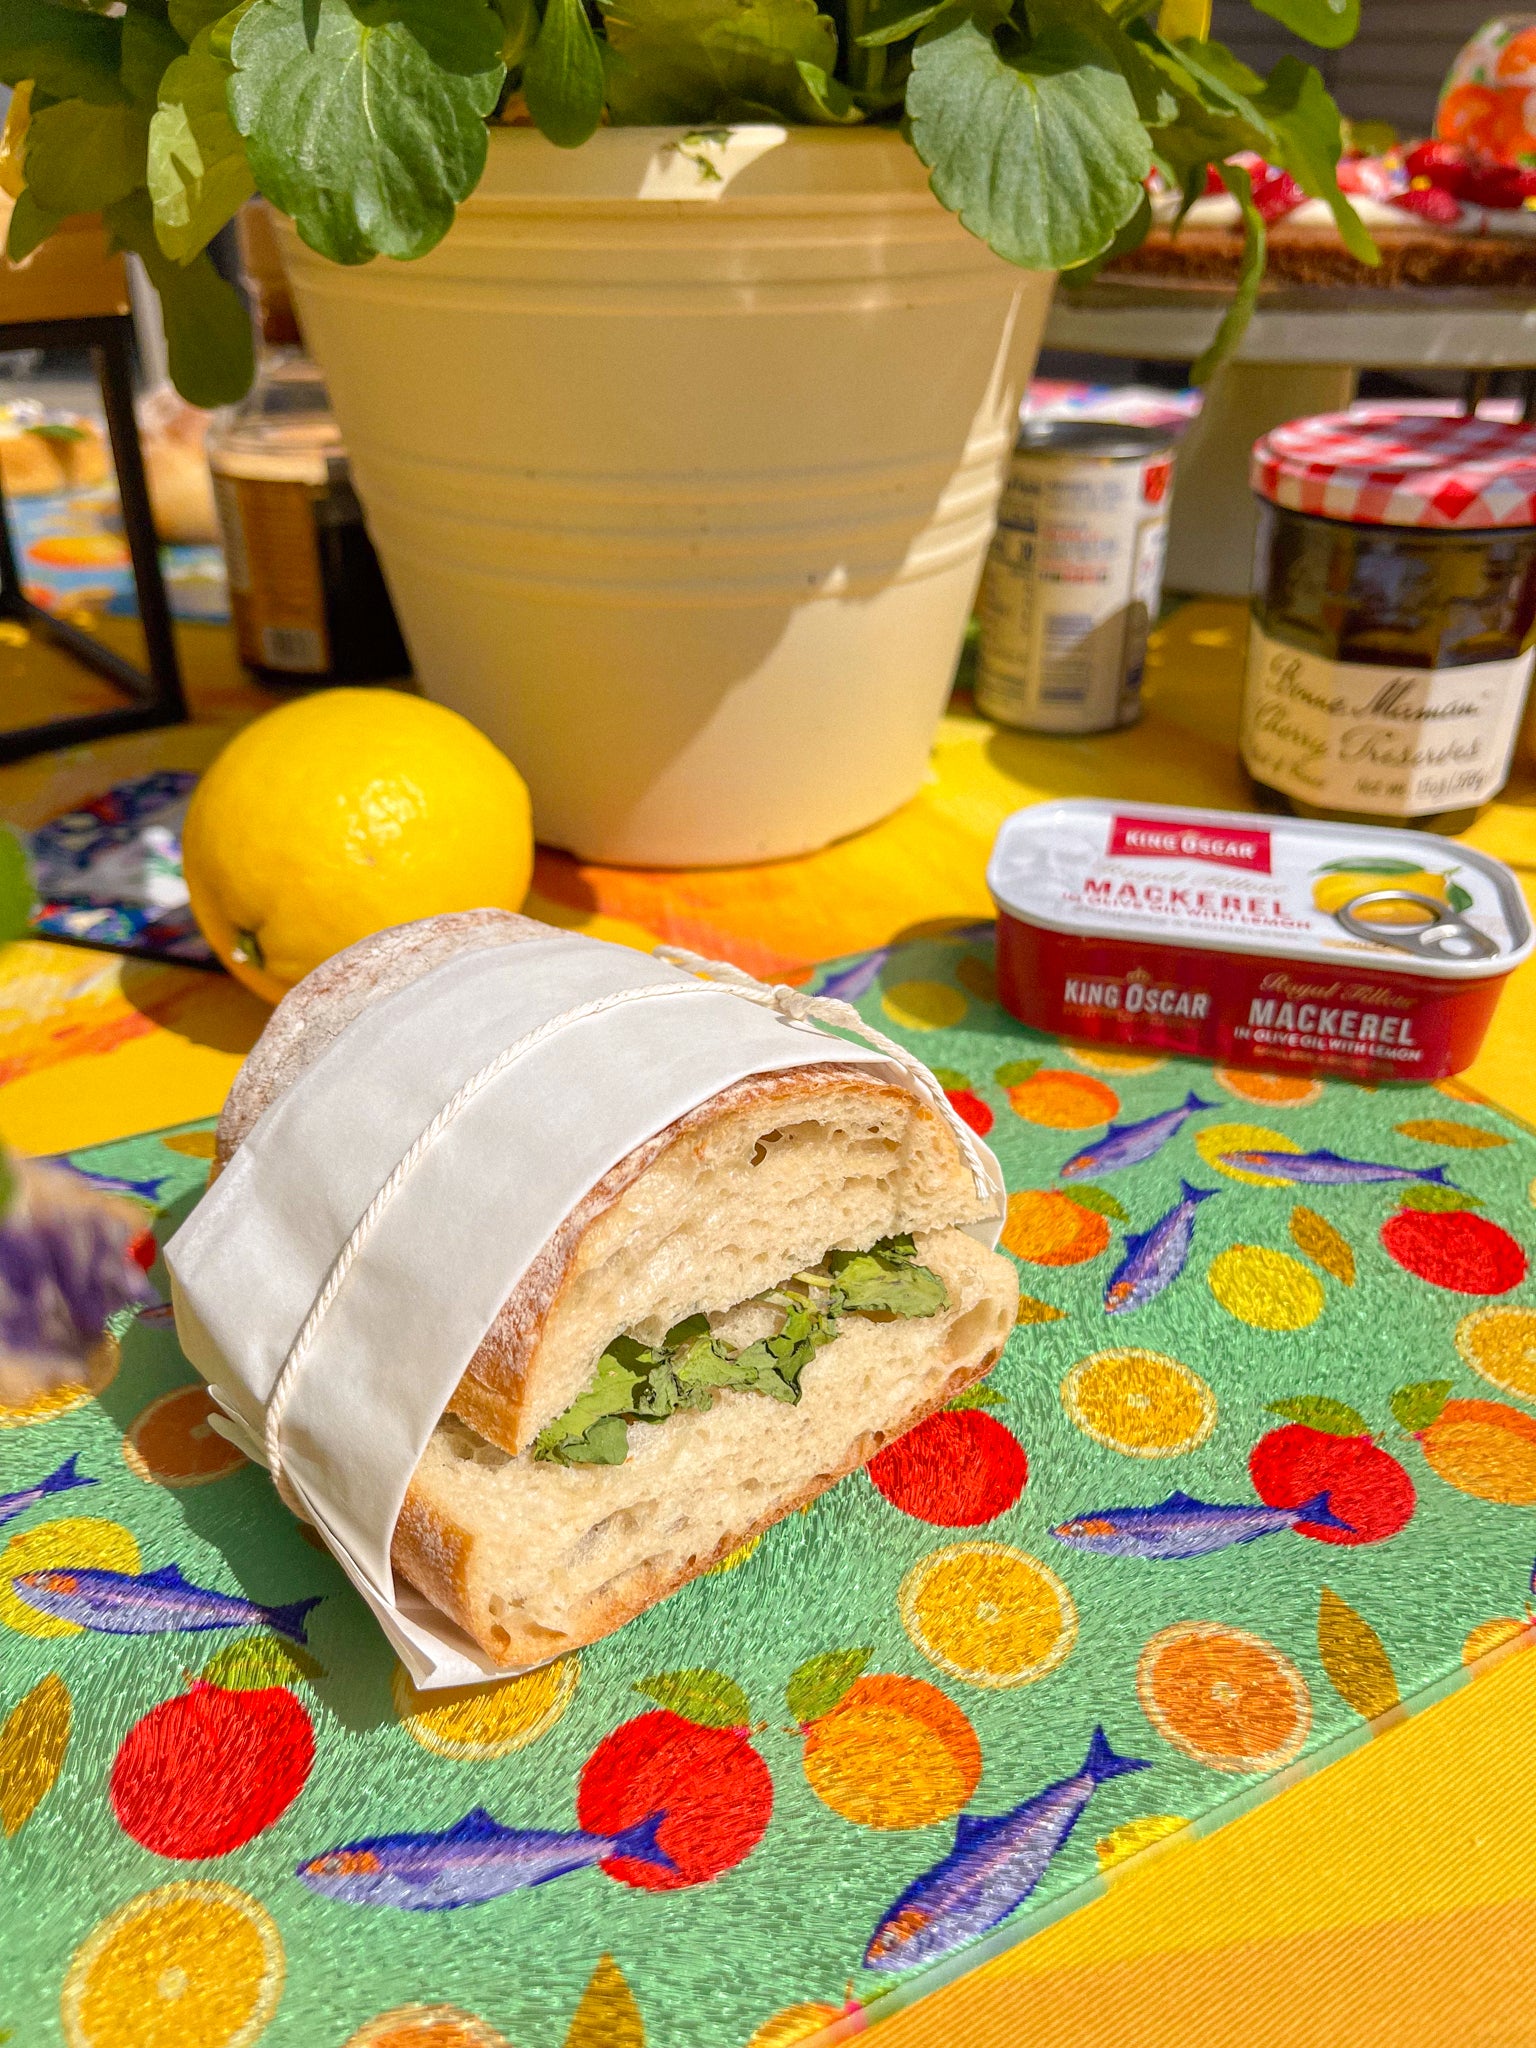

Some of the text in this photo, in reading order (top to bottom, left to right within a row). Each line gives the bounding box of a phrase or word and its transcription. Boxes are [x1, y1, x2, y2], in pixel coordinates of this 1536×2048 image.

[1125, 830, 1176, 851] KING
[1083, 877, 1291, 918] MACKEREL
[1086, 893, 1143, 910] OLIVE
[1152, 902, 1181, 915] OIL
[1184, 905, 1236, 922] WITH
[1241, 911, 1311, 930] LEMON
[1064, 978, 1120, 1009] KING
[1125, 983, 1211, 1019] OSCAR
[1248, 998, 1415, 1046] MACKEREL
[1234, 1026, 1250, 1040] IN
[1253, 1028, 1300, 1047] OLIVE
[1300, 1034, 1327, 1050] OIL
[1328, 1038, 1366, 1055] WITH
[1368, 1042, 1424, 1062] LEMON
